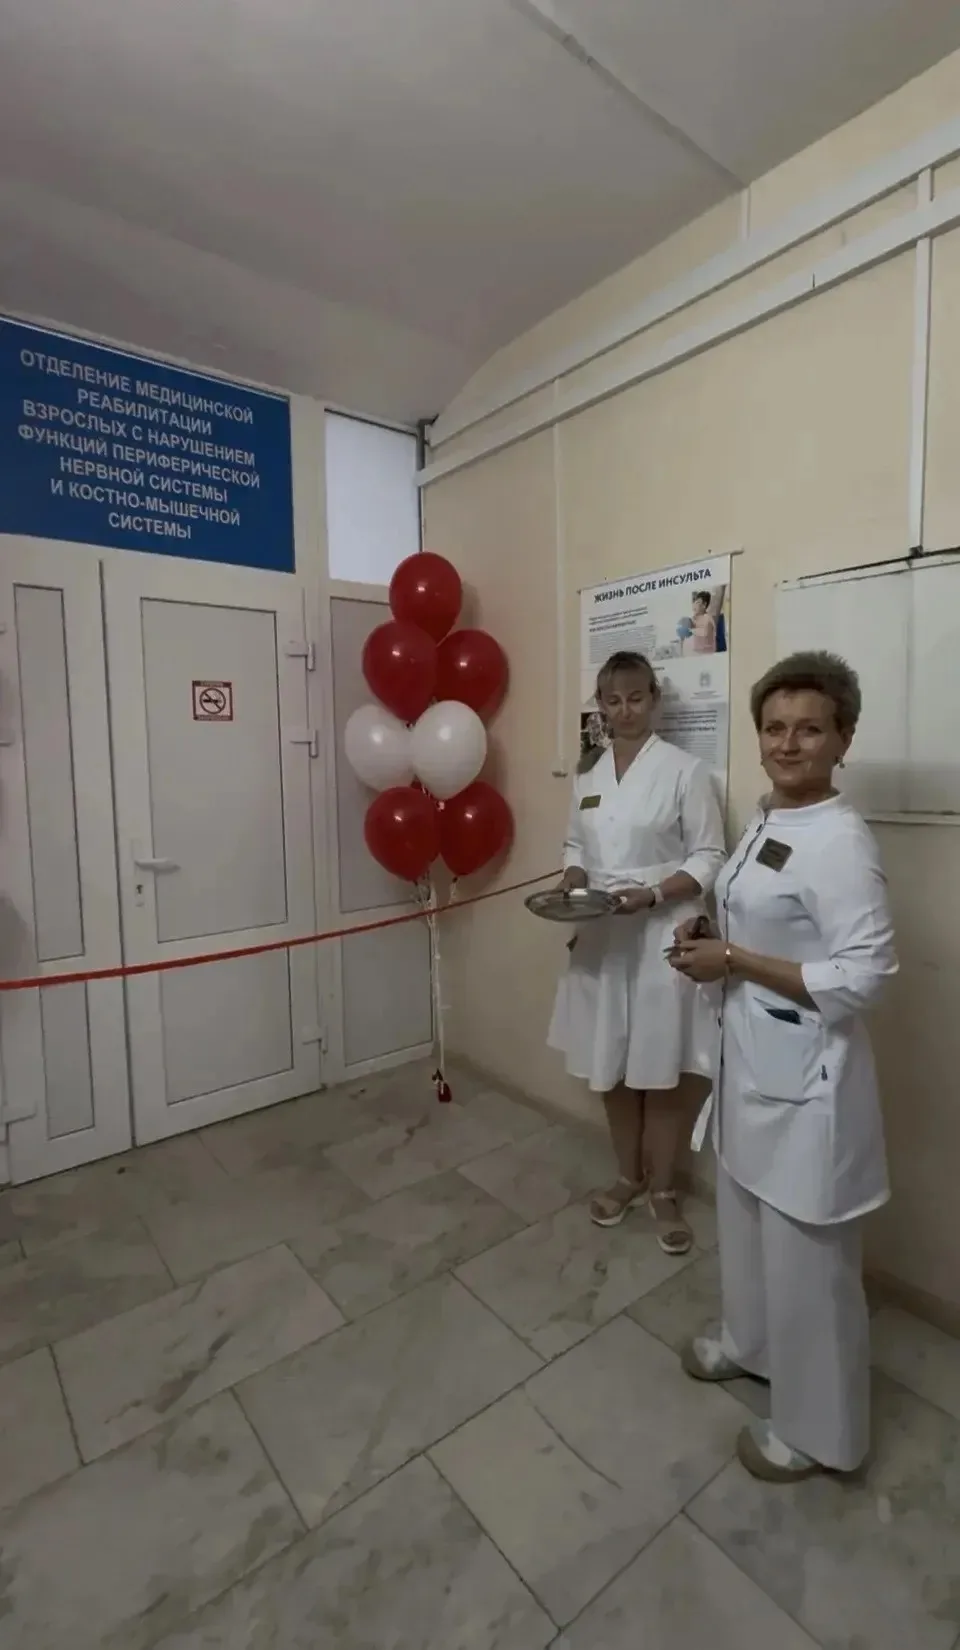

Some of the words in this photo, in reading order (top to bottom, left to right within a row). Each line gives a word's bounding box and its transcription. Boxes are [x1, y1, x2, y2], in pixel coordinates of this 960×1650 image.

[20, 349, 131, 392] ОТДЕЛЕНИЕ
[136, 380, 254, 424] МЕДИЦИНСКОЙ
[23, 399, 127, 438] ВЗРОСЛЫХ
[132, 426, 143, 441] С
[148, 430, 256, 466] НАРУШЕНИЕМ
[77, 388, 213, 435] РЕАБИЛИТАЦИИ
[18, 424, 108, 457] ФУНКЦИЙ
[113, 443, 261, 489] ПЕРИФЕРИЧЕСКОЙ
[60, 456, 144, 486] НЕРВНОЙ
[149, 474, 228, 503] СИСТЕМЫ
[50, 478, 63, 496] И
[69, 481, 241, 526] КОСТНО-МЫШЕЧНОЙ
[108, 512, 192, 539] СИСТЕМЫ
[594, 589, 624, 603] ЖИЗНЬ
[625, 581, 657, 596] ПОСЛЕ
[658, 568, 712, 588] ИНСУЛЬТА
